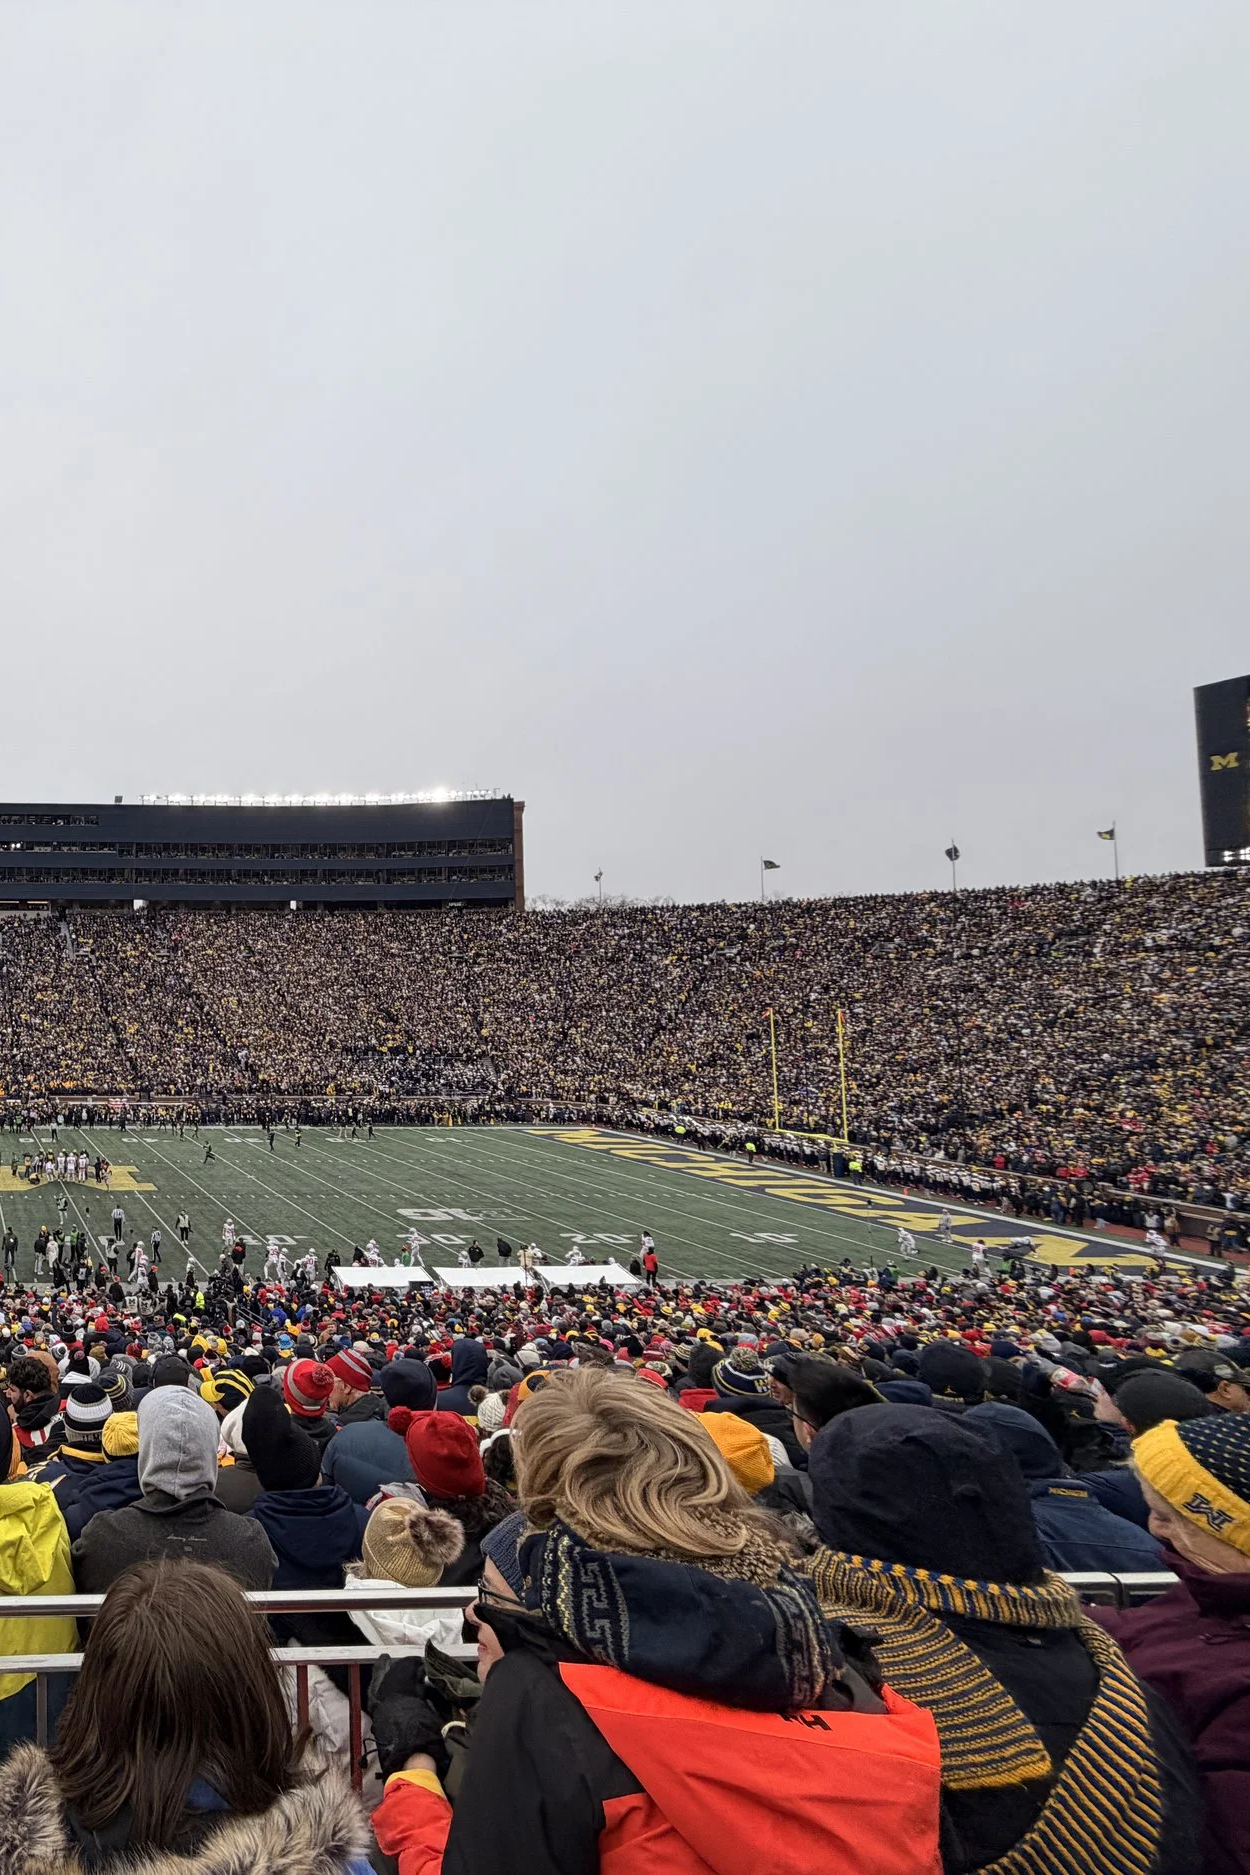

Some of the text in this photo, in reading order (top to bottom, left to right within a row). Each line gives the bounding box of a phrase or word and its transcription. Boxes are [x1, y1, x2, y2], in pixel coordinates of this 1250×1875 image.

[1210, 752, 1240, 771] M
[528, 1129, 1200, 1270] MICHIGAN
[559, 1233, 635, 1244] 20
[729, 1232, 799, 1243] 10
[1182, 1492, 1234, 1532] M
